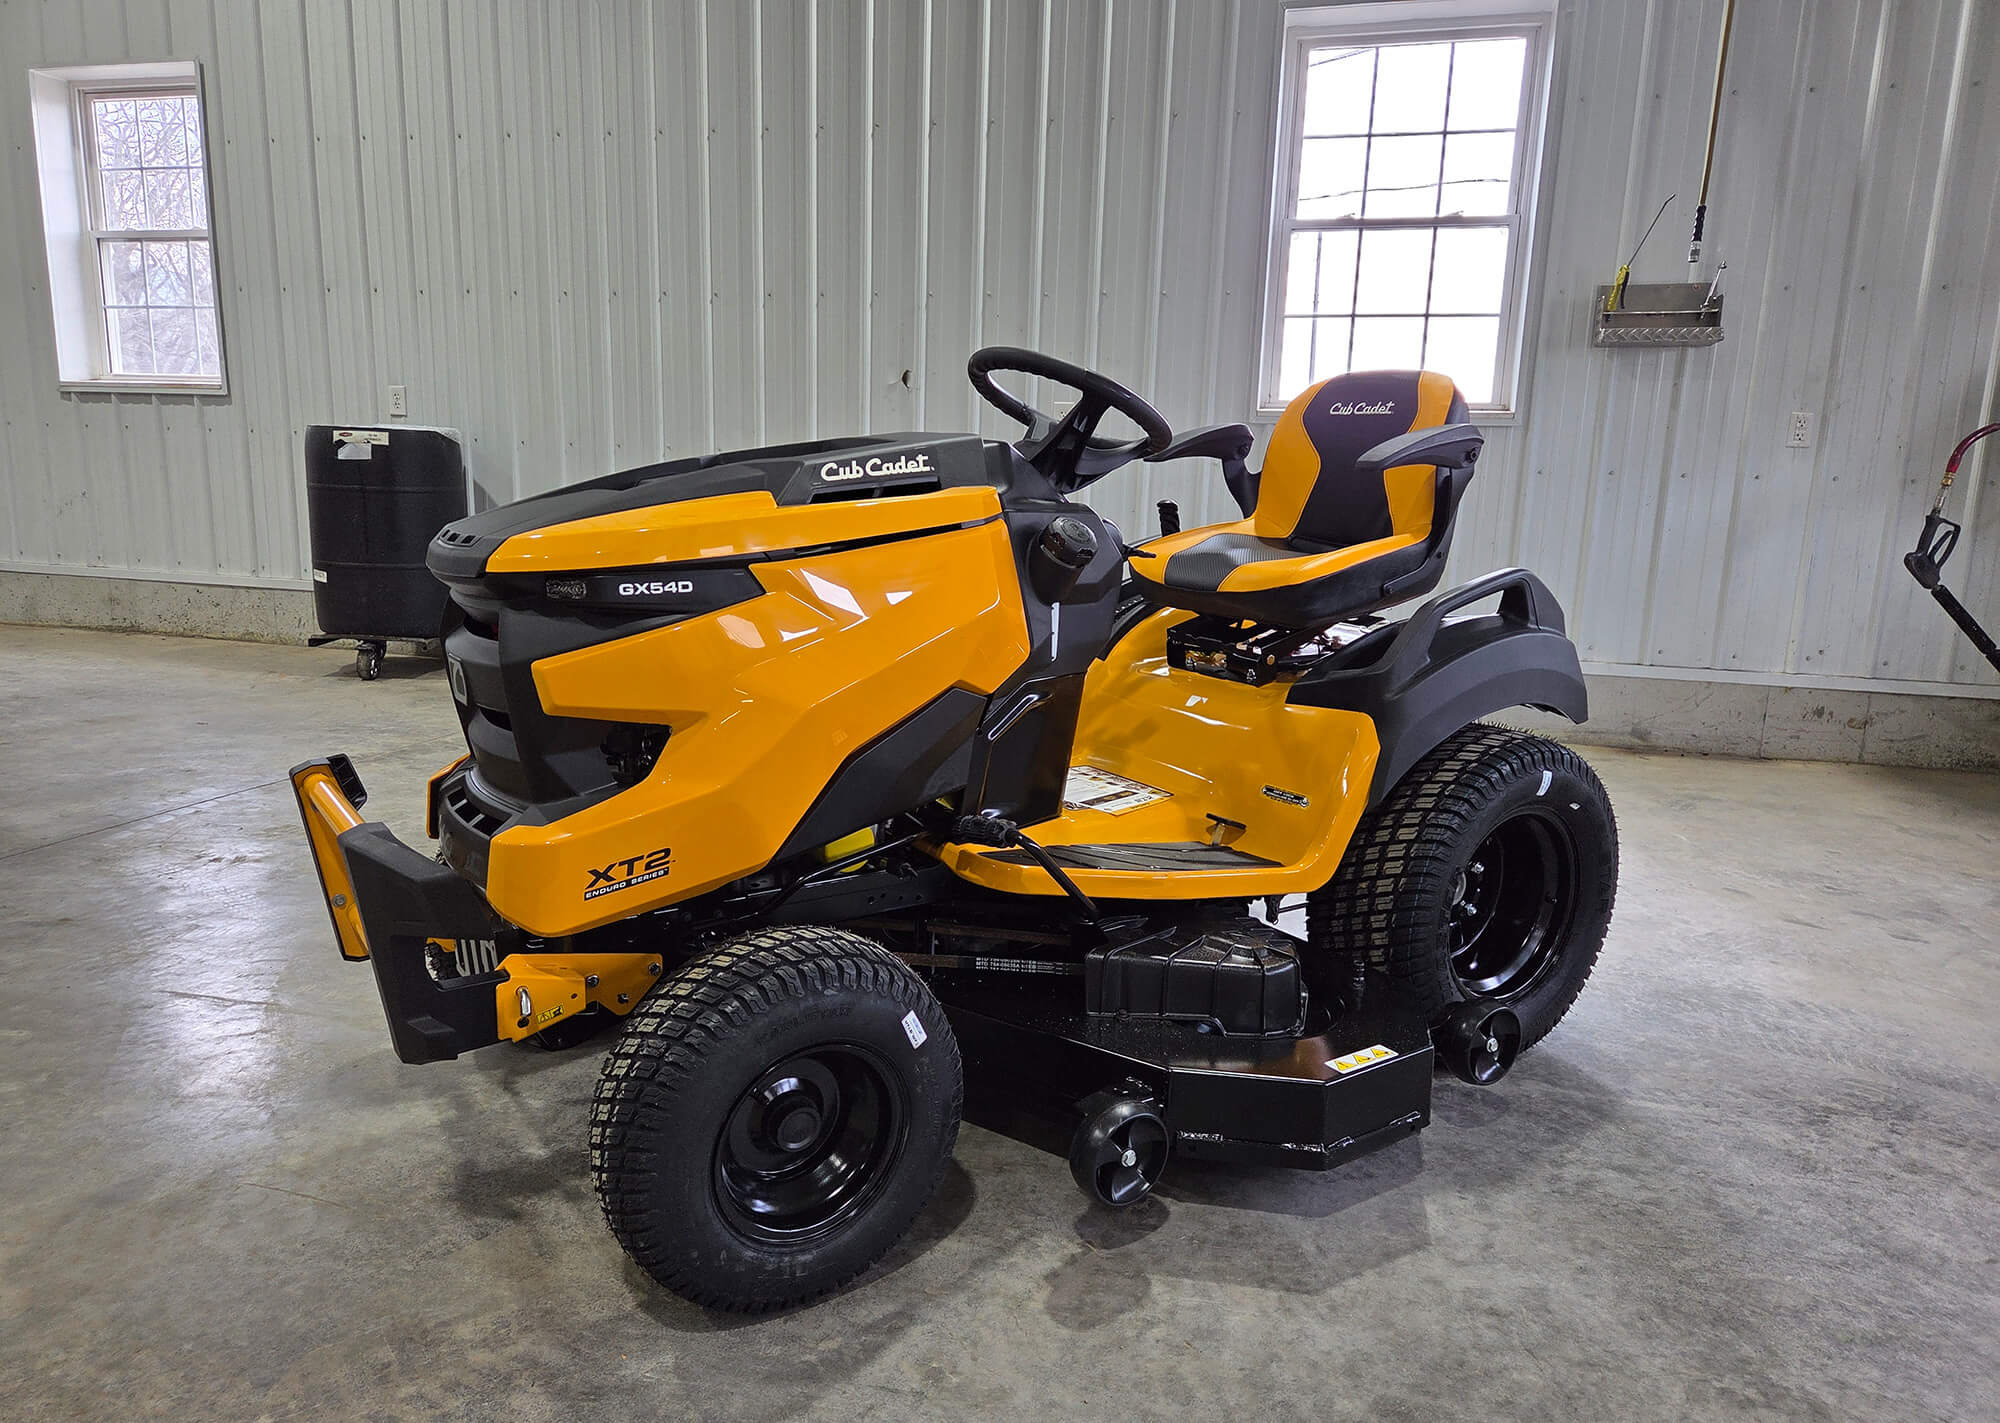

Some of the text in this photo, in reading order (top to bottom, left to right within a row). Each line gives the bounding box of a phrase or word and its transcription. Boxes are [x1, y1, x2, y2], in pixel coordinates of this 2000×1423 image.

[1330, 401, 1395, 415] Cub Cadet
[820, 454, 929, 481] Cub Cadet
[618, 581, 694, 596] GX54D
[585, 847, 672, 889] XT2
[585, 881, 627, 899] ENDURO
